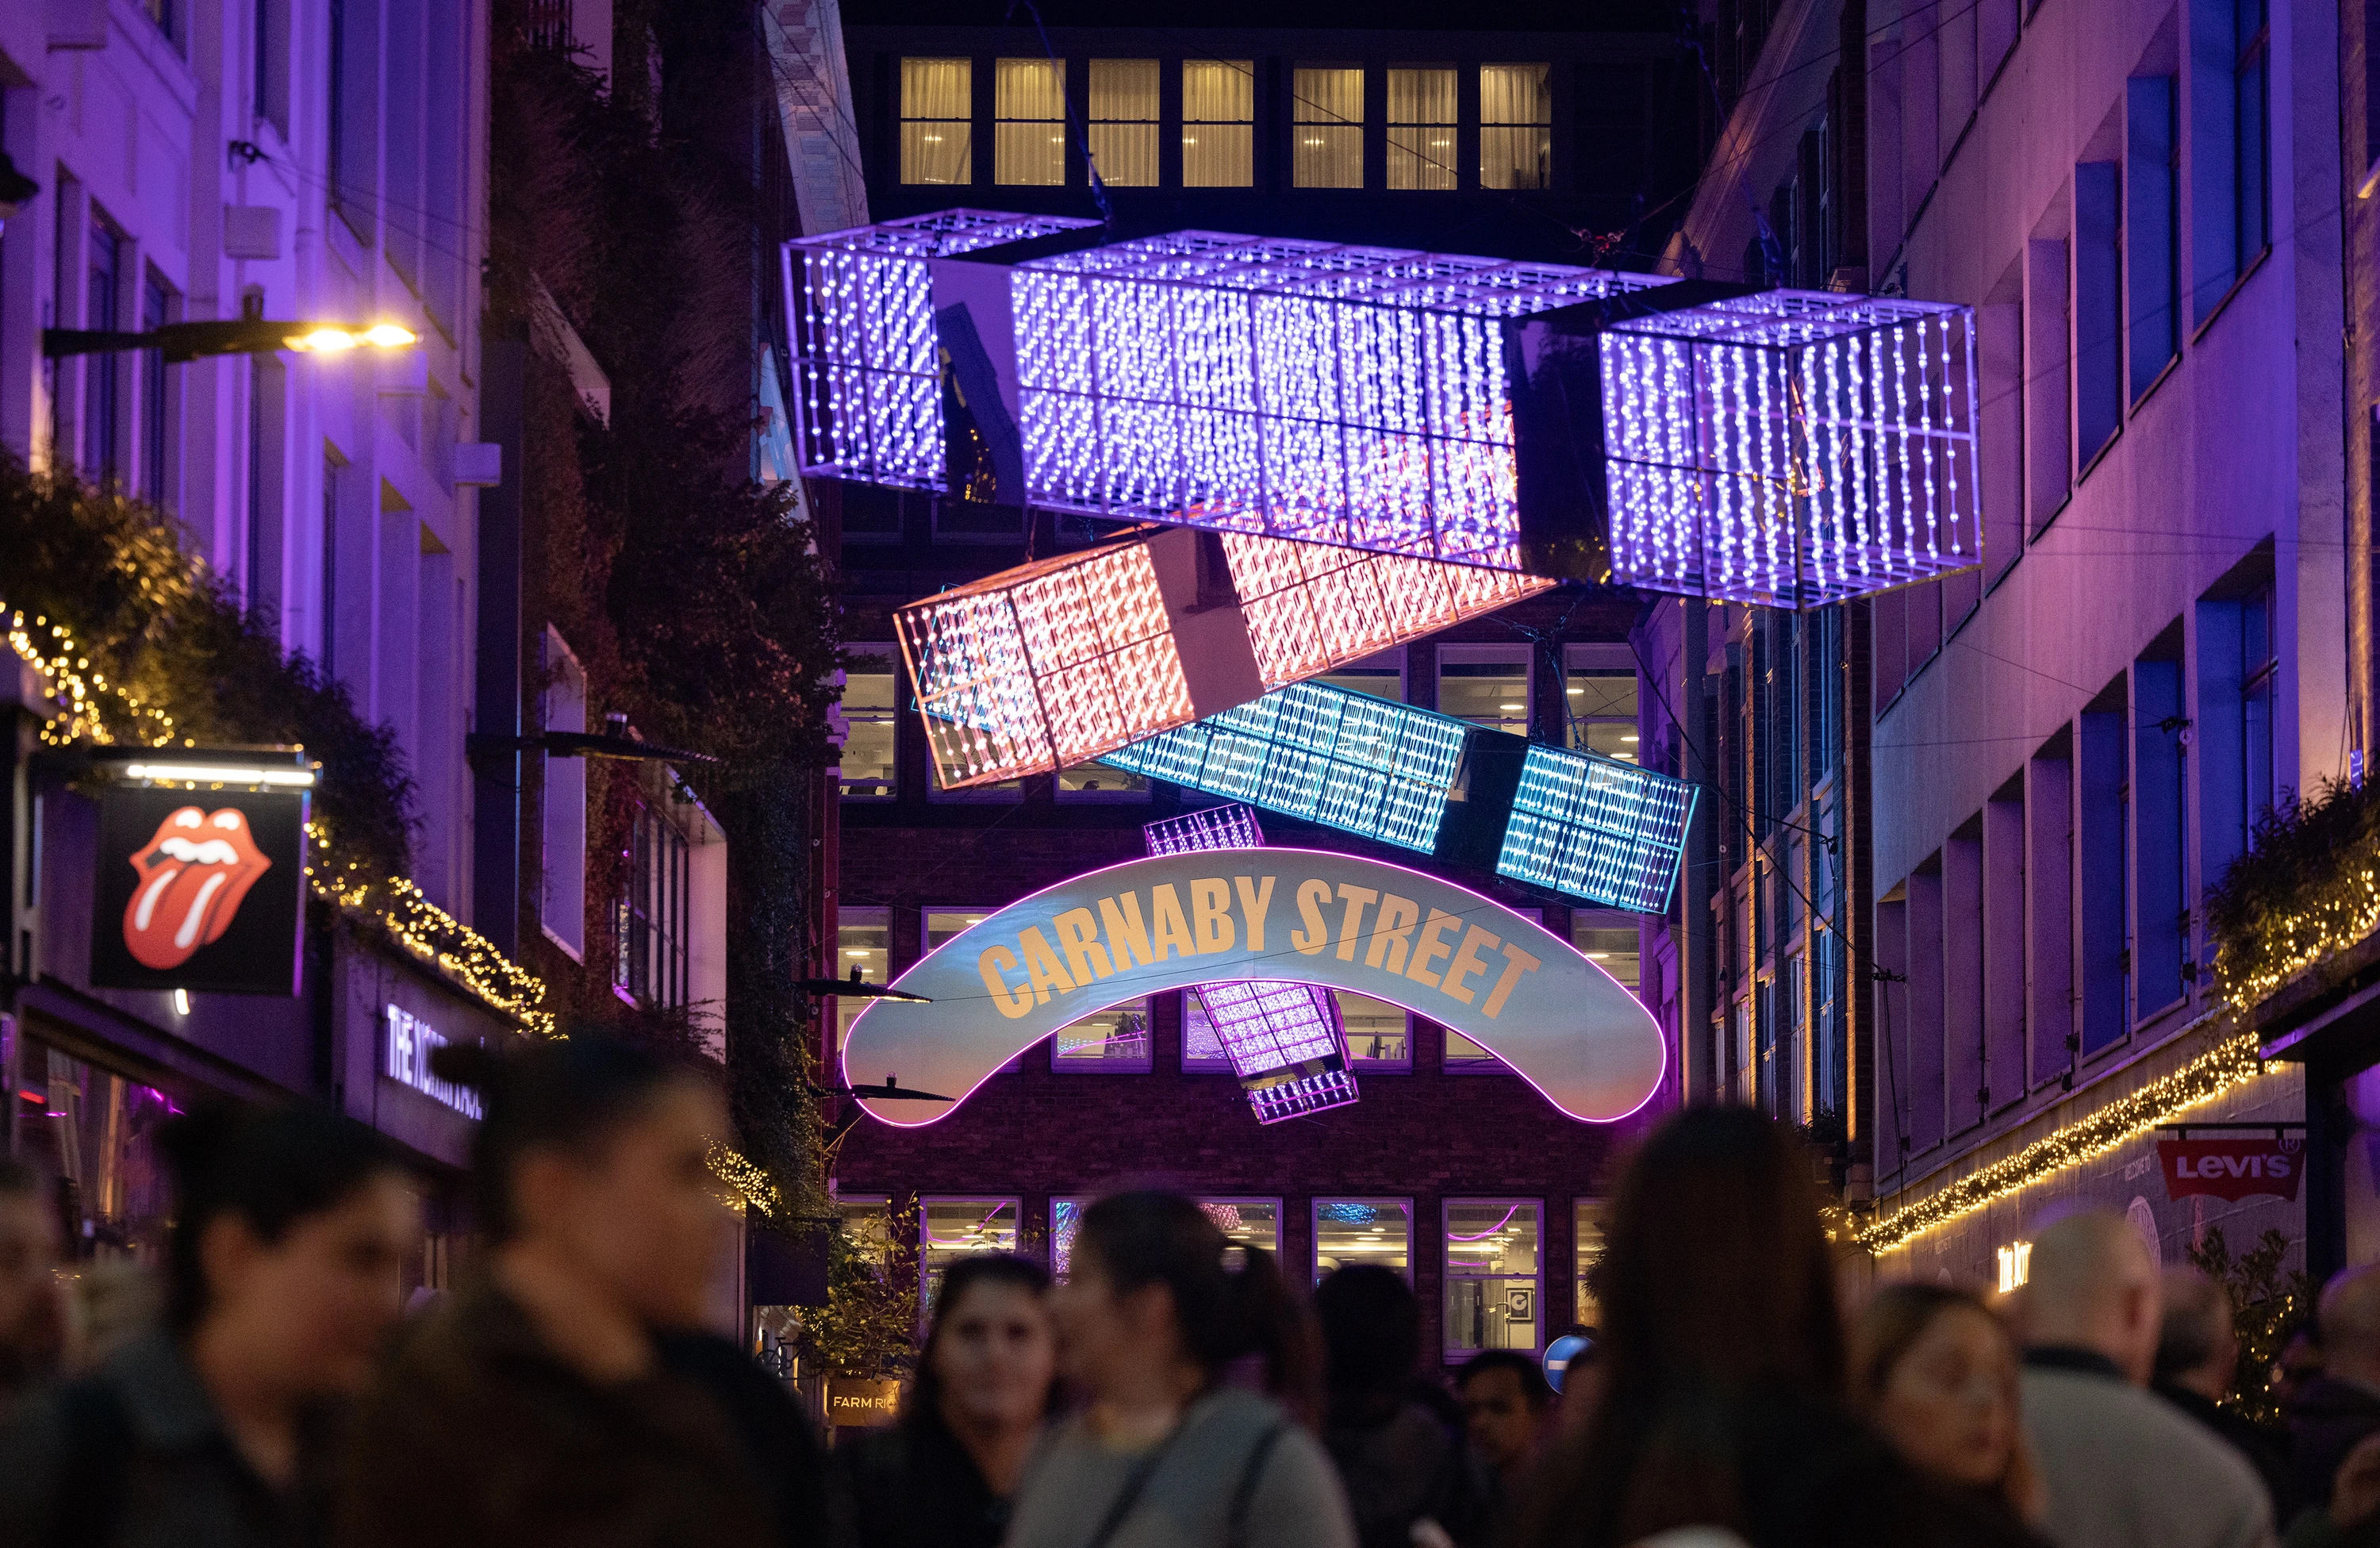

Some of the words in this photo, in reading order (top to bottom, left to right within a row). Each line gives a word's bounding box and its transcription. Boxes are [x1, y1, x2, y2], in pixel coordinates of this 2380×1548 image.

[977, 875, 1276, 1019] CARNABY
[1290, 878, 1541, 1020] STREET
[387, 1003, 414, 1085] THE
[833, 1396, 872, 1408] FARM
